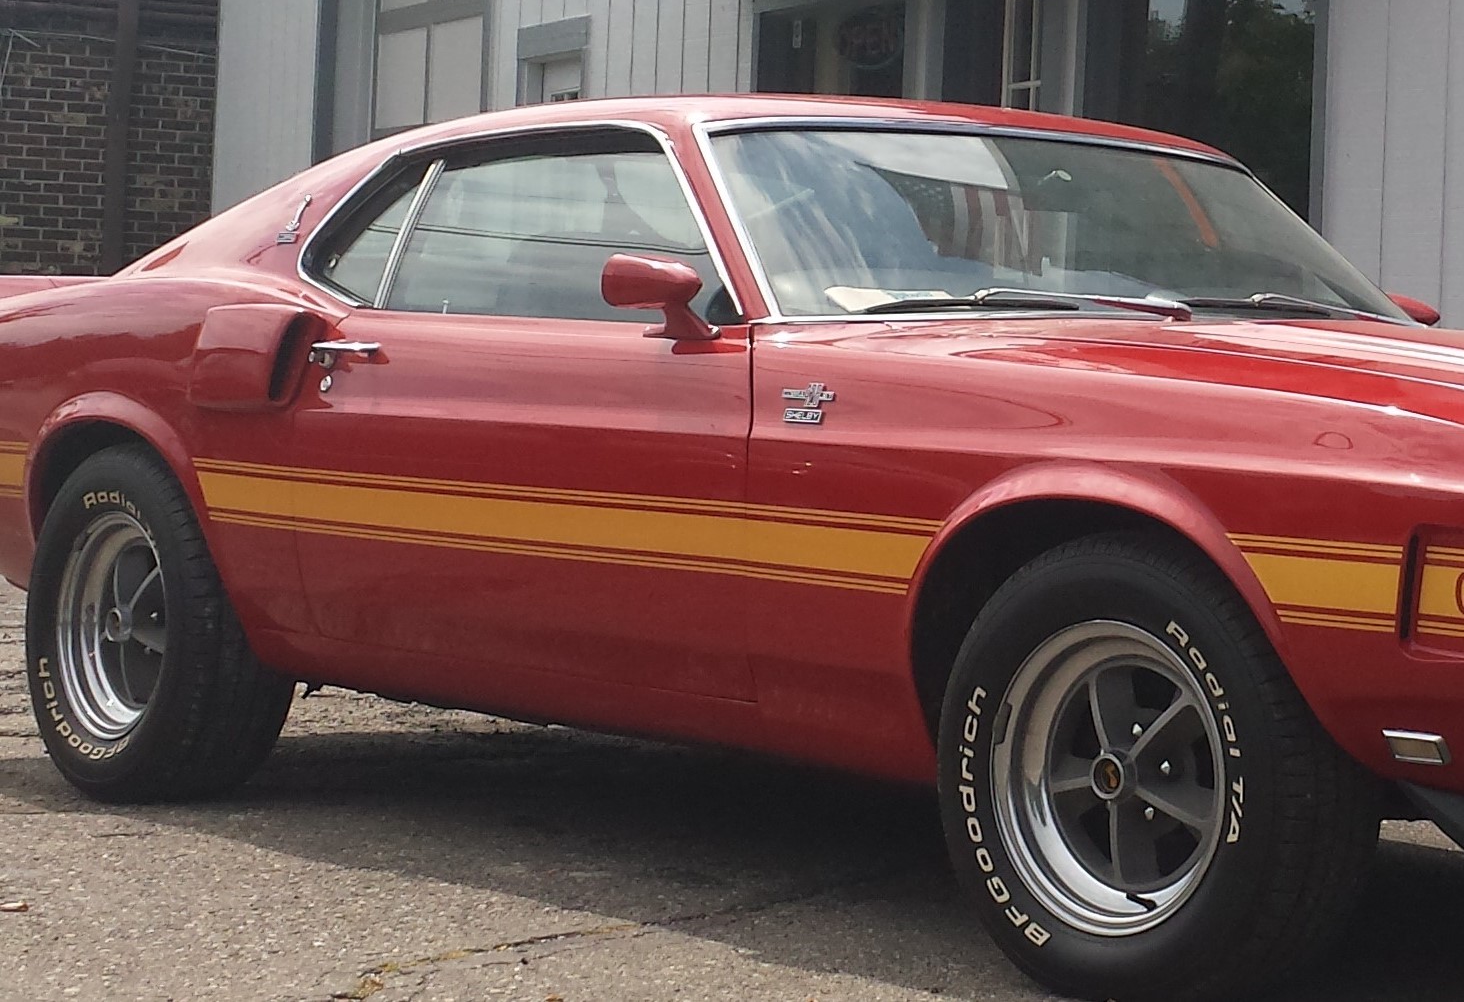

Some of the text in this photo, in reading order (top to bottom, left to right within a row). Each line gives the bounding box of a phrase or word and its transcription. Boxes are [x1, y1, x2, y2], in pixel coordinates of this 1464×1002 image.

[83, 490, 141, 520] Radial
[958, 686, 1051, 947] BFGoodrich
[1165, 620, 1246, 845] Radial T/A
